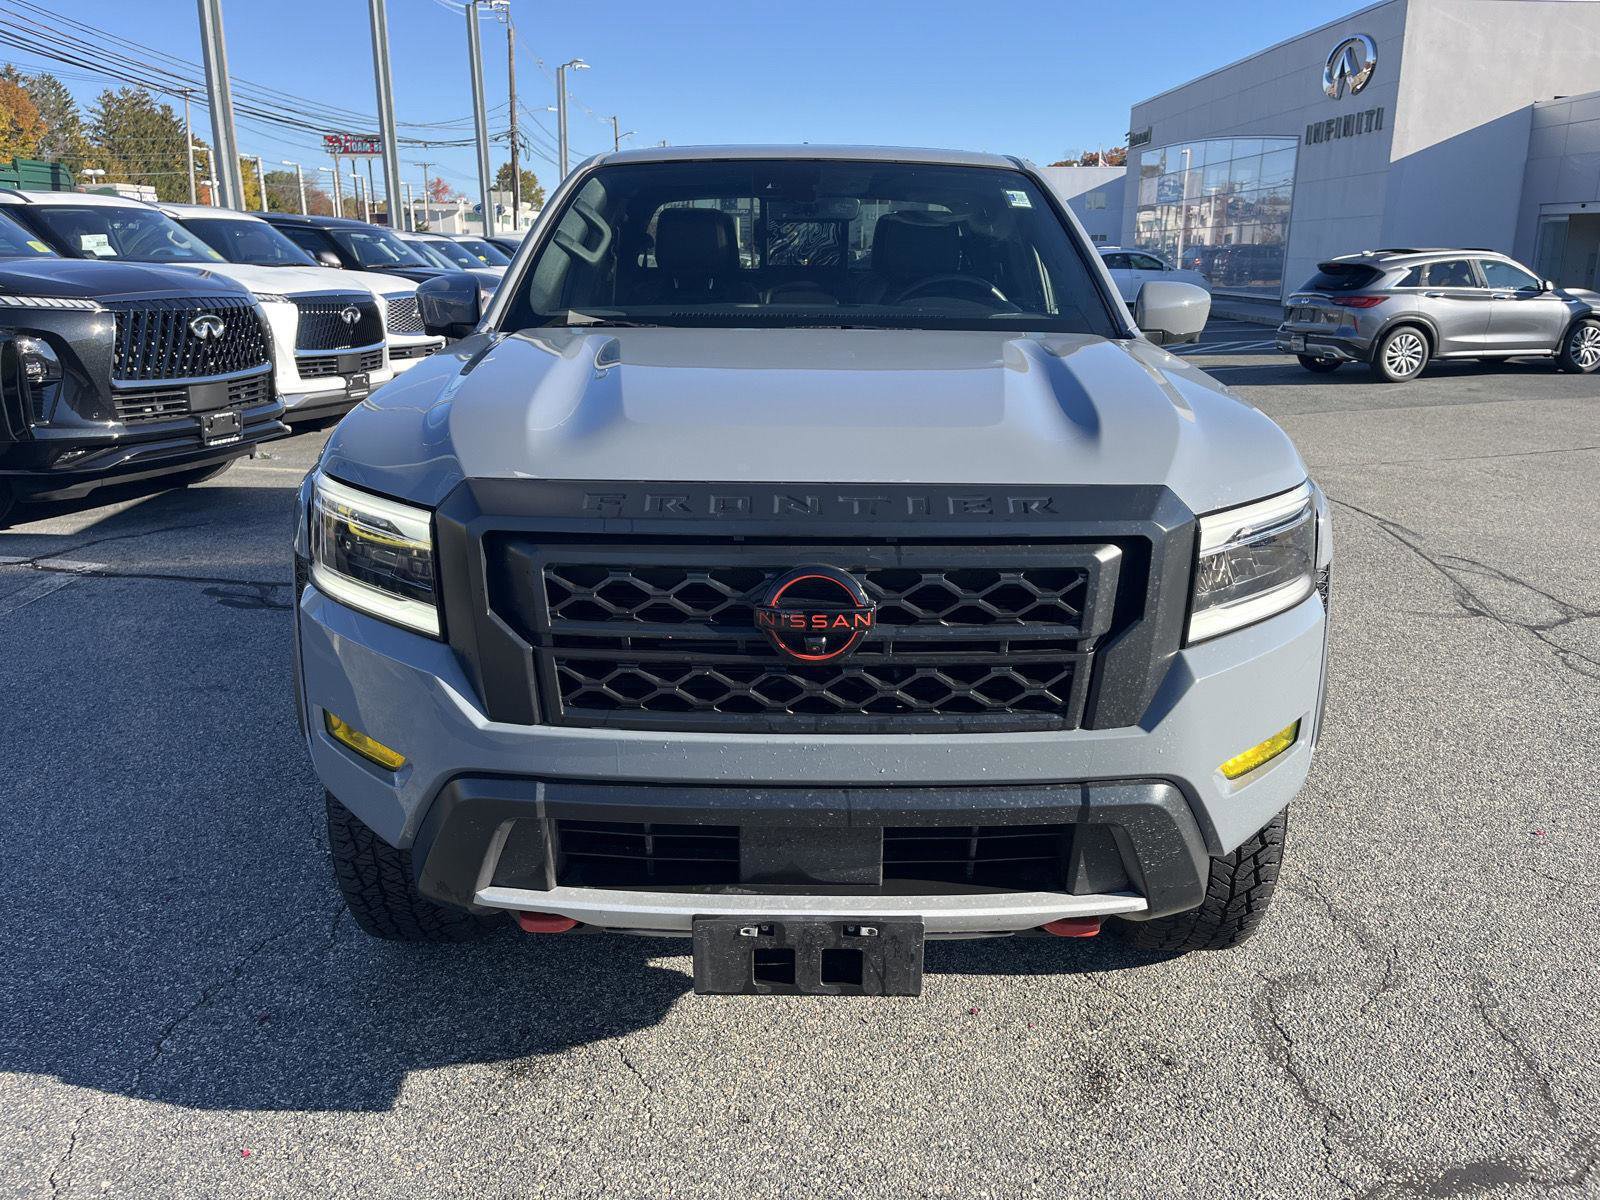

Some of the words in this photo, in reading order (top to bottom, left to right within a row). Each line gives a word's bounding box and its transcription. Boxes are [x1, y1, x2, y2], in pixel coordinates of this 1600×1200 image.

[1305, 107, 1384, 145] INFINITI
[580, 492, 1060, 517] FRONTIER
[758, 611, 872, 629] NISSAN
